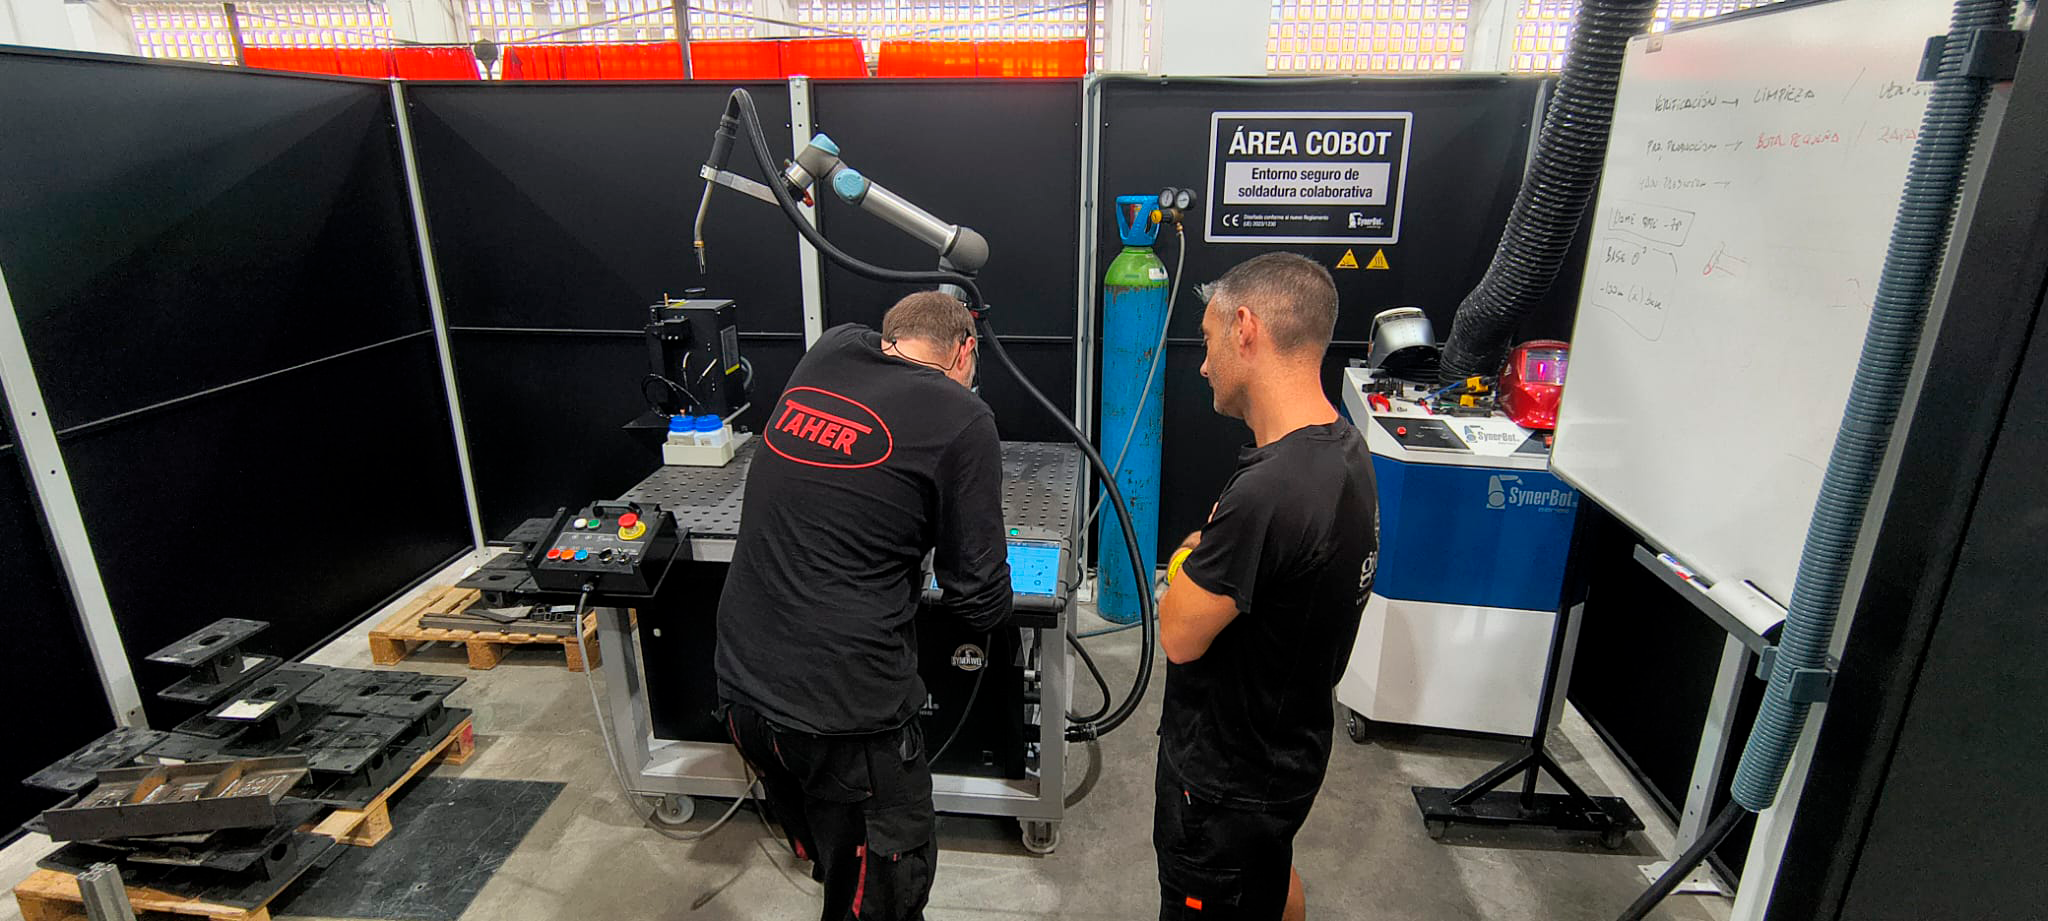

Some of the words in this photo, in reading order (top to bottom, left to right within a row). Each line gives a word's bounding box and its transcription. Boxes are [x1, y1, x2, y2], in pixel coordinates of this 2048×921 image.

[1753, 84, 1816, 104] LIMPIEZA
[1228, 125, 1298, 155] ÁREA
[1305, 131, 1392, 155] COBOT
[1251, 167, 1298, 181] Entorno
[1300, 170, 1341, 183] seguro
[1344, 168, 1360, 181] de
[1238, 185, 1297, 198] soldadura
[1299, 185, 1373, 198] colaborativa
[1222, 213, 1240, 227] CE
[775, 399, 873, 456] TAHER
[1509, 486, 1574, 507] SynerBot
